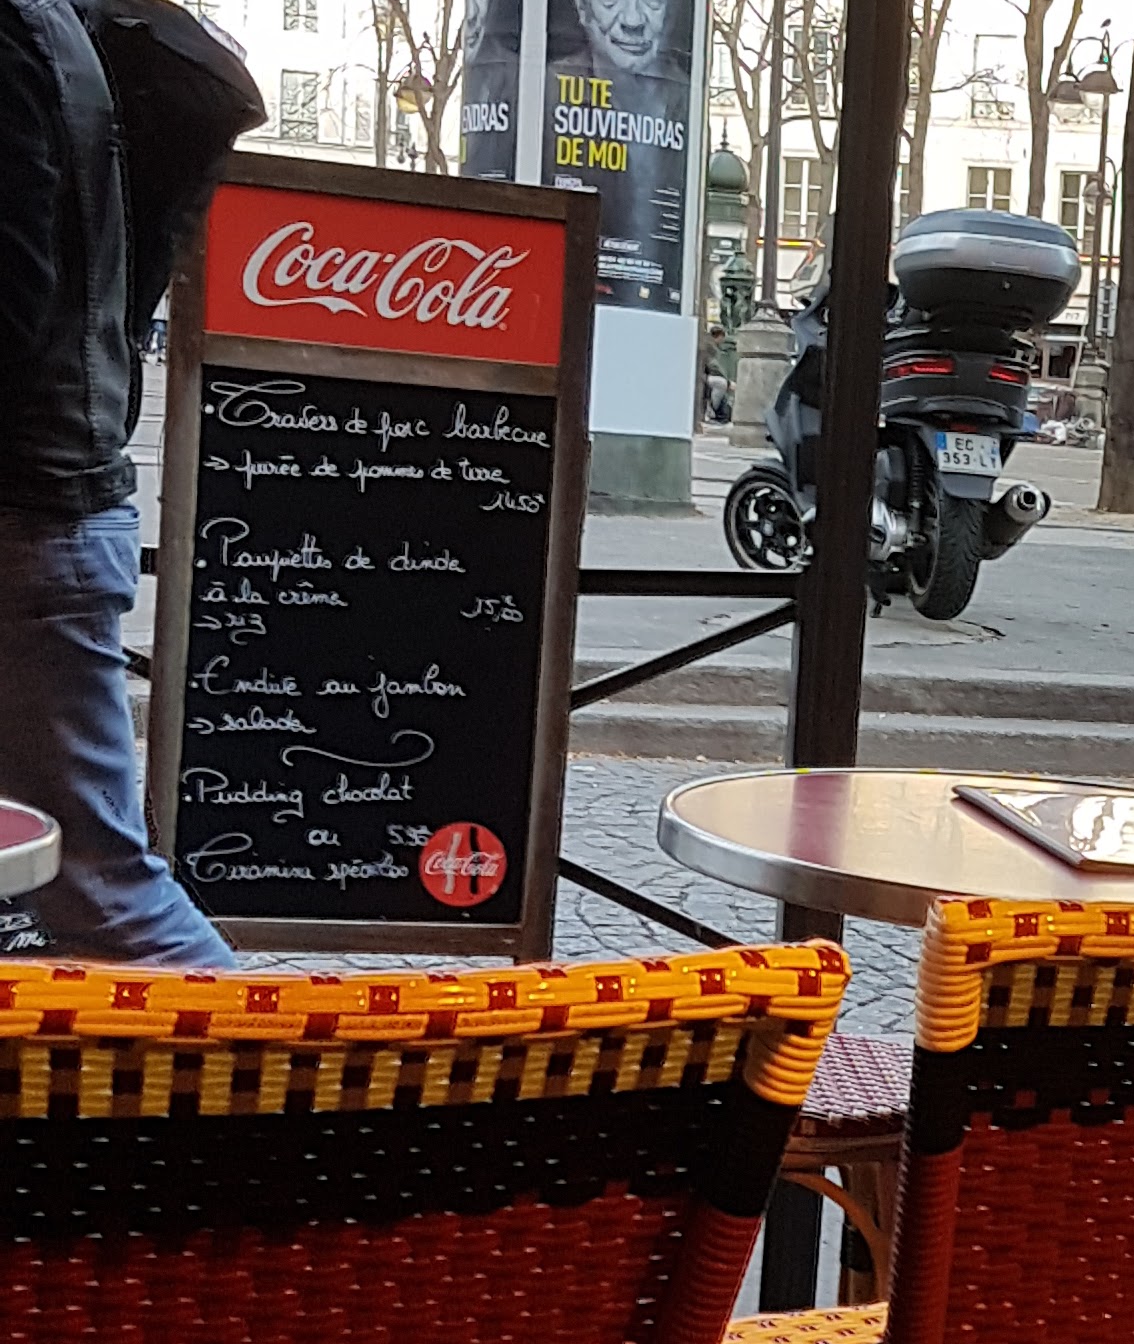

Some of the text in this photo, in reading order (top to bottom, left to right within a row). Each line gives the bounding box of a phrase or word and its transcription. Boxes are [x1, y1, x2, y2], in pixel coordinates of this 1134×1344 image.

[556, 74, 613, 109] TU TE
[554, 106, 685, 151] SOUVIENDRAS
[556, 136, 627, 172] DE MOI
[345, 407, 368, 434] de
[371, 411, 431, 453] porc
[310, 455, 341, 477] de
[431, 459, 453, 481] de
[345, 545, 376, 570] de
[389, 540, 467, 573] dinde
[234, 577, 270, 605] la
[316, 680, 361, 697] au
[368, 656, 467, 719] jambon
[218, 705, 317, 735] salade
[183, 767, 414, 823] Pudding chocolat
[308, 828, 340, 847] ou
